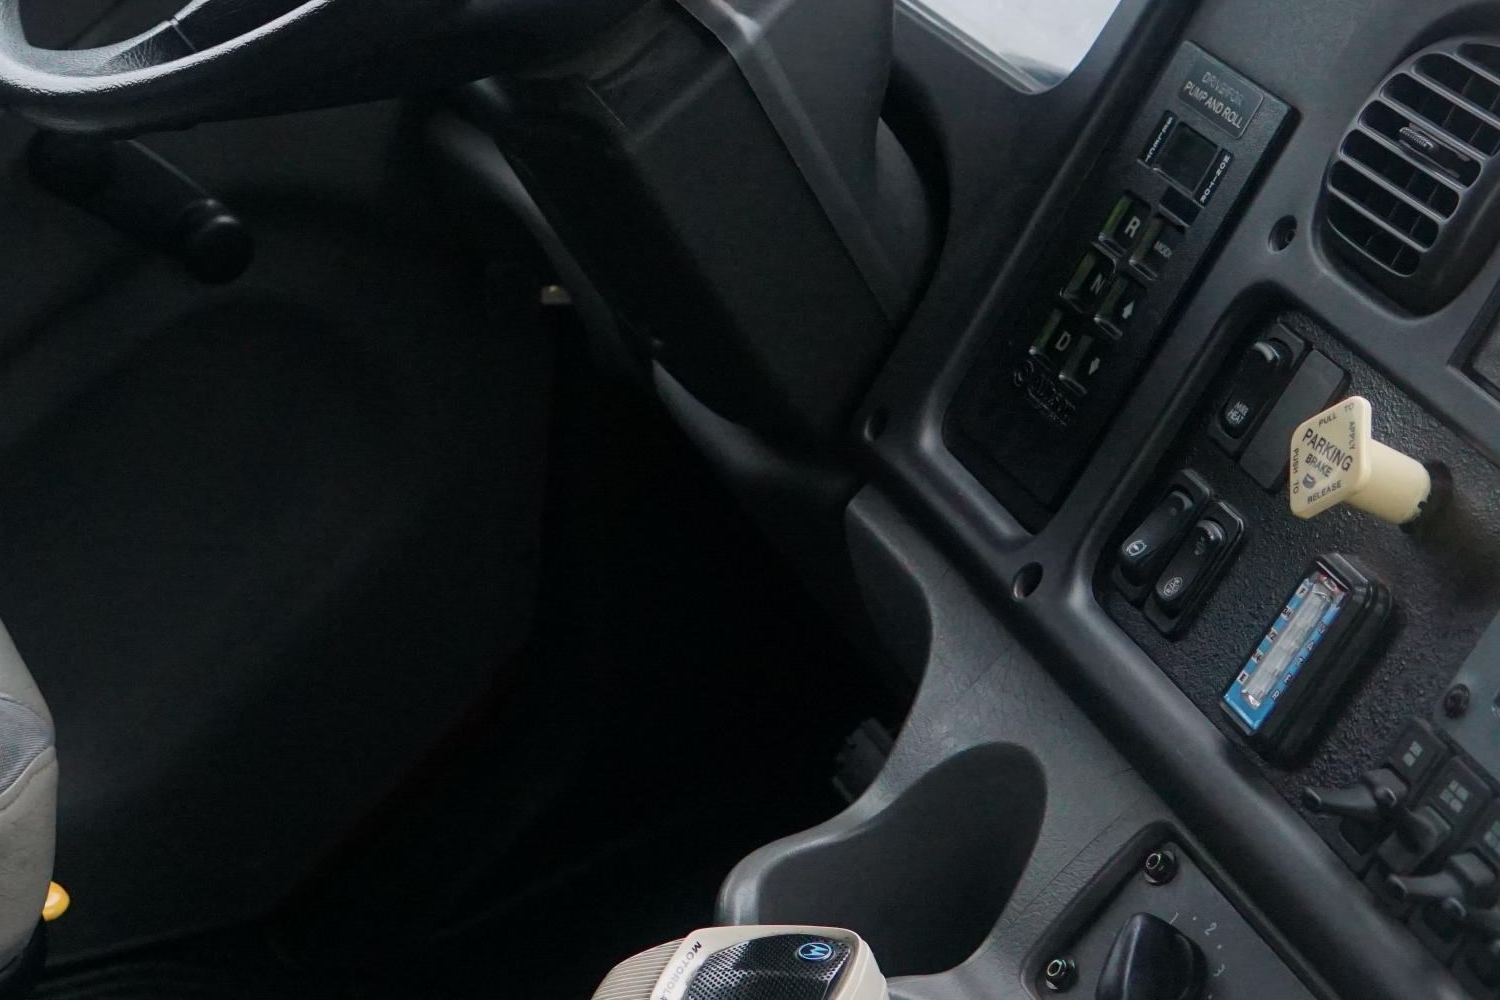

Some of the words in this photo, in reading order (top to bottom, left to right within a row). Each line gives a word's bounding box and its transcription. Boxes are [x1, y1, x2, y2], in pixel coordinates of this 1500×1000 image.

[1182, 80, 1209, 103] PUMP
[1204, 96, 1224, 115] AND
[1220, 106, 1245, 129] ROLL
[1143, 115, 1174, 163] SELECT
[1199, 154, 1231, 204] MONITOR
[1124, 215, 1141, 239] R
[1088, 272, 1107, 296] N
[1054, 330, 1072, 353] D
[1227, 408, 1245, 425] HEAT
[1318, 412, 1338, 427] PULL
[1344, 402, 1355, 413] TO
[1348, 421, 1356, 450] APPLY
[1302, 428, 1353, 473] PARKING
[1305, 453, 1333, 478] BRAKE
[1293, 479, 1300, 494] TO
[1306, 479, 1343, 504] RELEASE
[1203, 921, 1218, 936] 2
